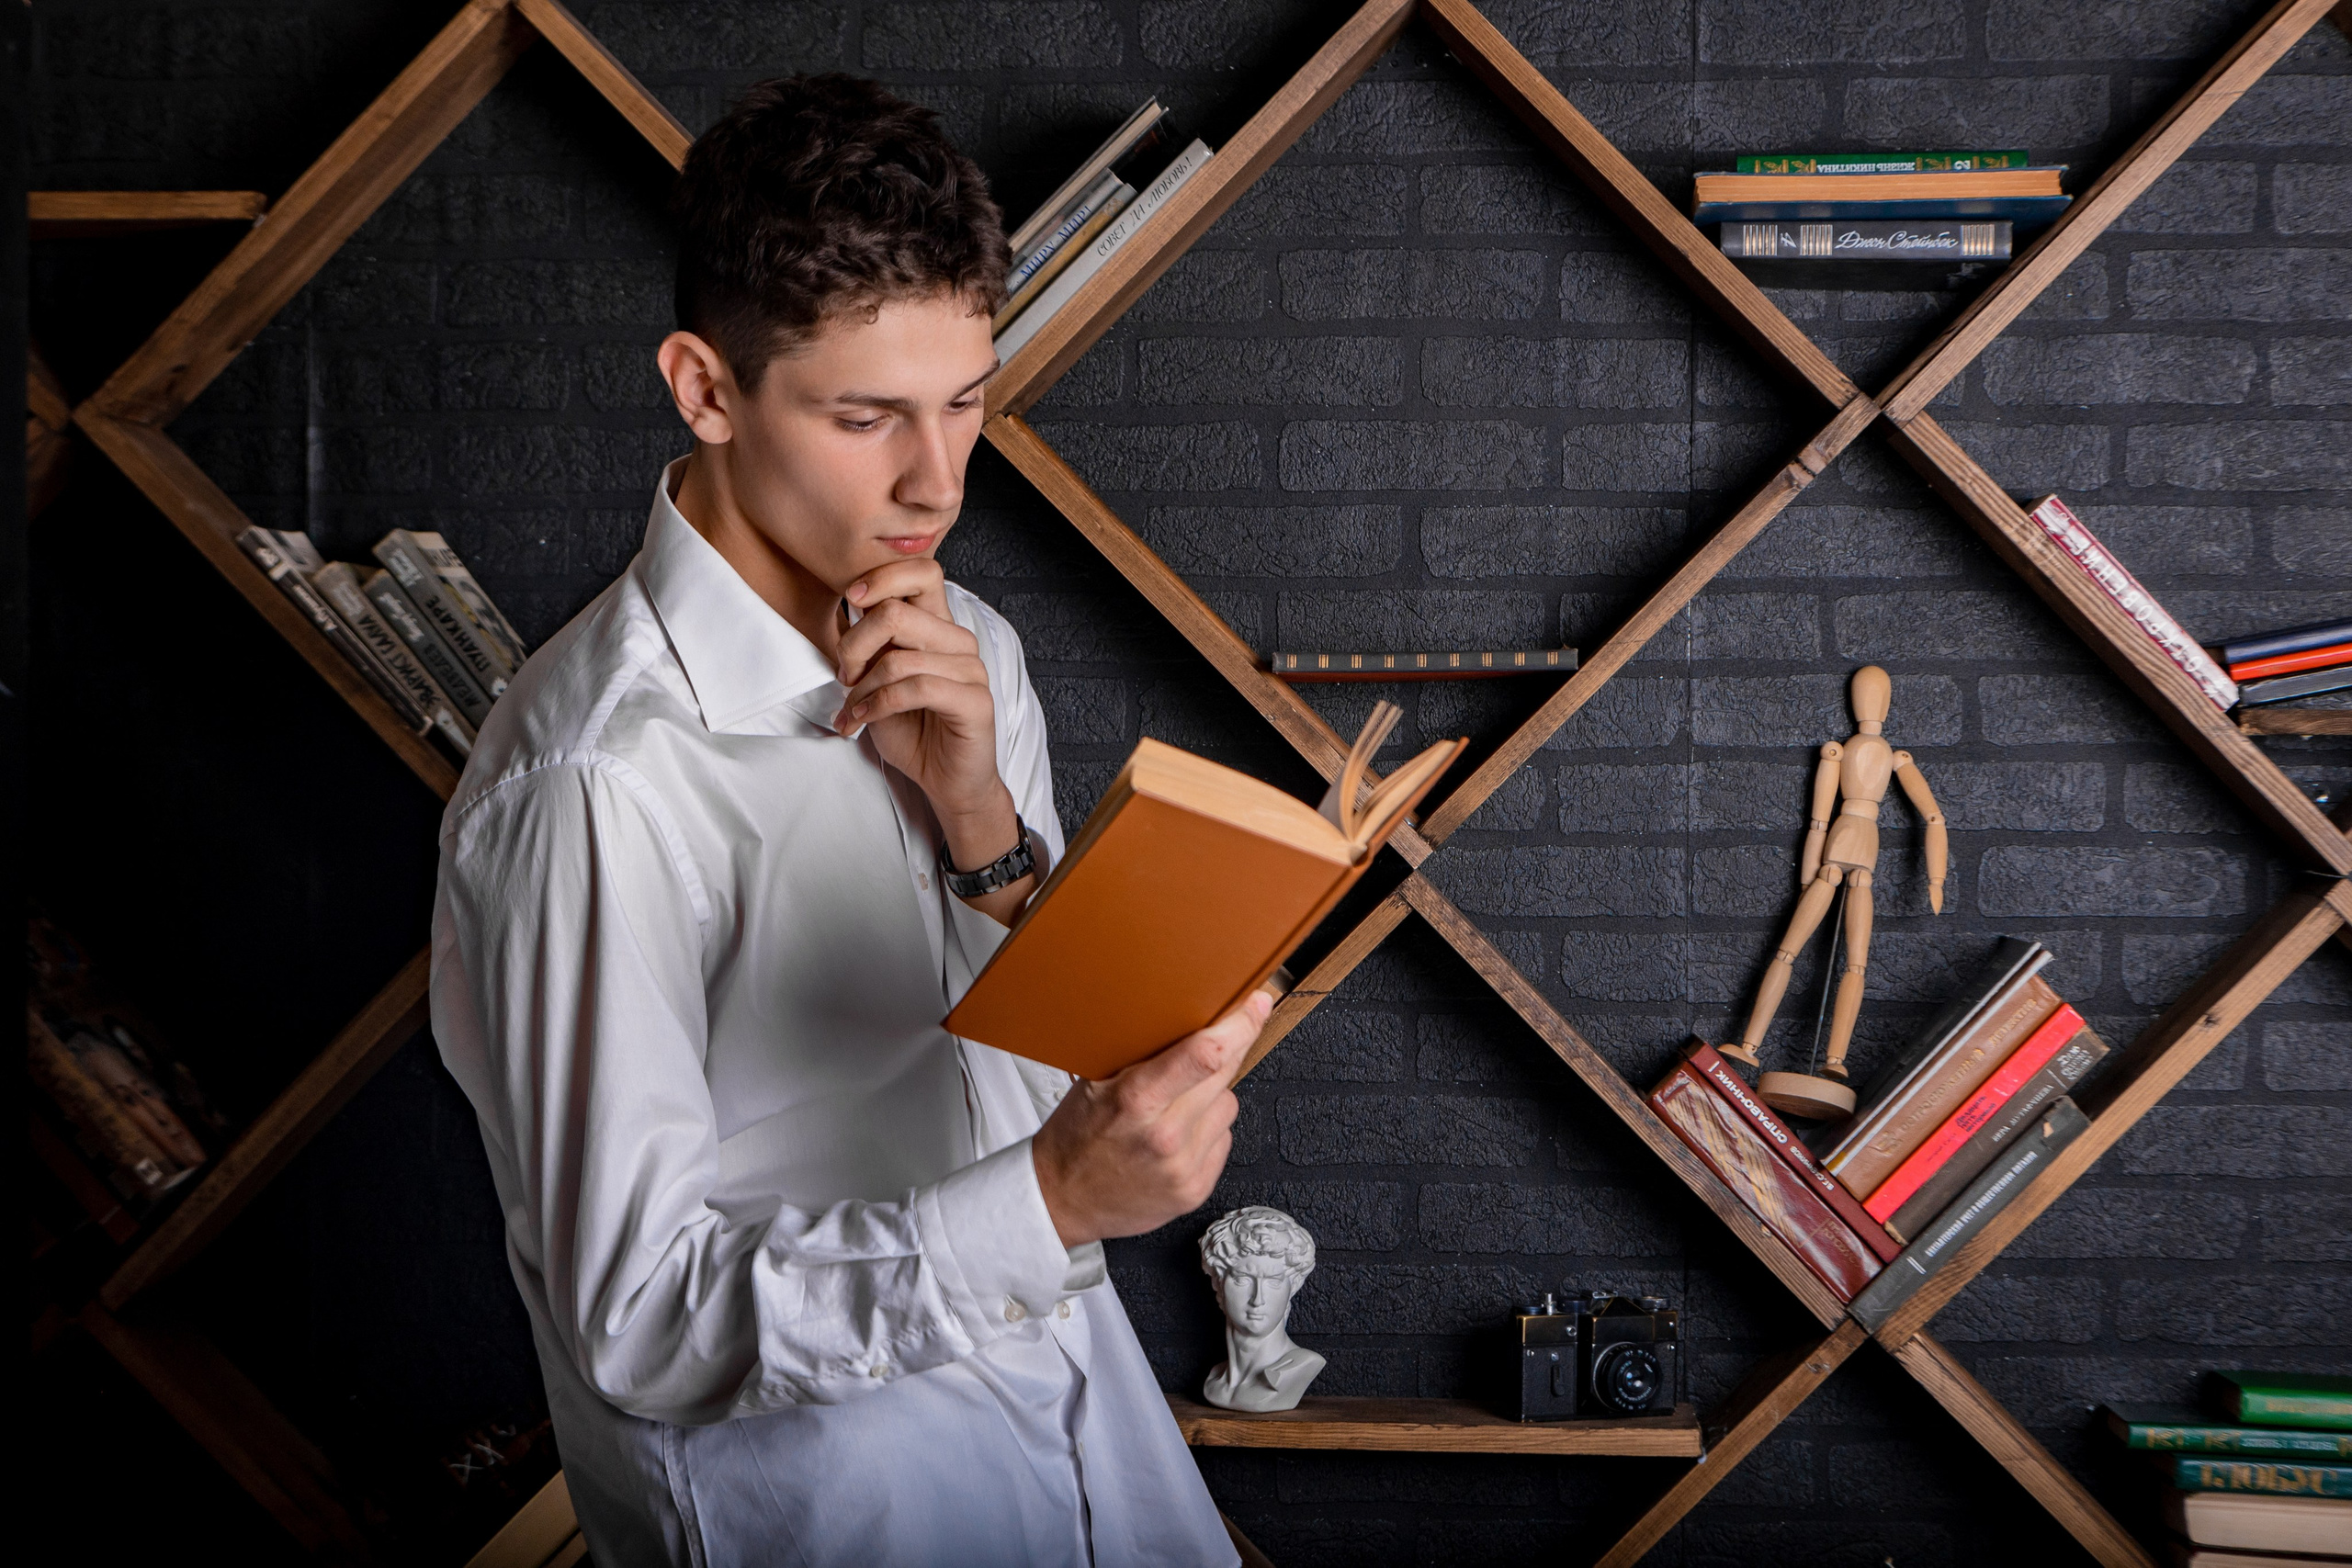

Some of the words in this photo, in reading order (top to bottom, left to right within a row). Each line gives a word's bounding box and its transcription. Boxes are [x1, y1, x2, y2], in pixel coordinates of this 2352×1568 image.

[1817, 163, 1876, 173] НИКИТИНА
[1877, 161, 1916, 172] ЖИЗНЬ
[1019, 241, 1057, 279] МИРУ
[1057, 204, 1094, 242] МИР!
[1094, 220, 1130, 257] СОВЕТ
[1125, 204, 1147, 226] ДА
[1143, 155, 1194, 208] ЛЮБОВЬ!
[1781, 232, 1797, 248] 4
[1835, 231, 1887, 249] Джон
[1887, 230, 1958, 249] Стейнбек
[423, 593, 492, 672] ПУАНКАРЕ
[2067, 535, 2206, 676] ОТКРОВЕНИЕ
[1714, 1068, 1789, 1145] СПРАВОЧНИК
